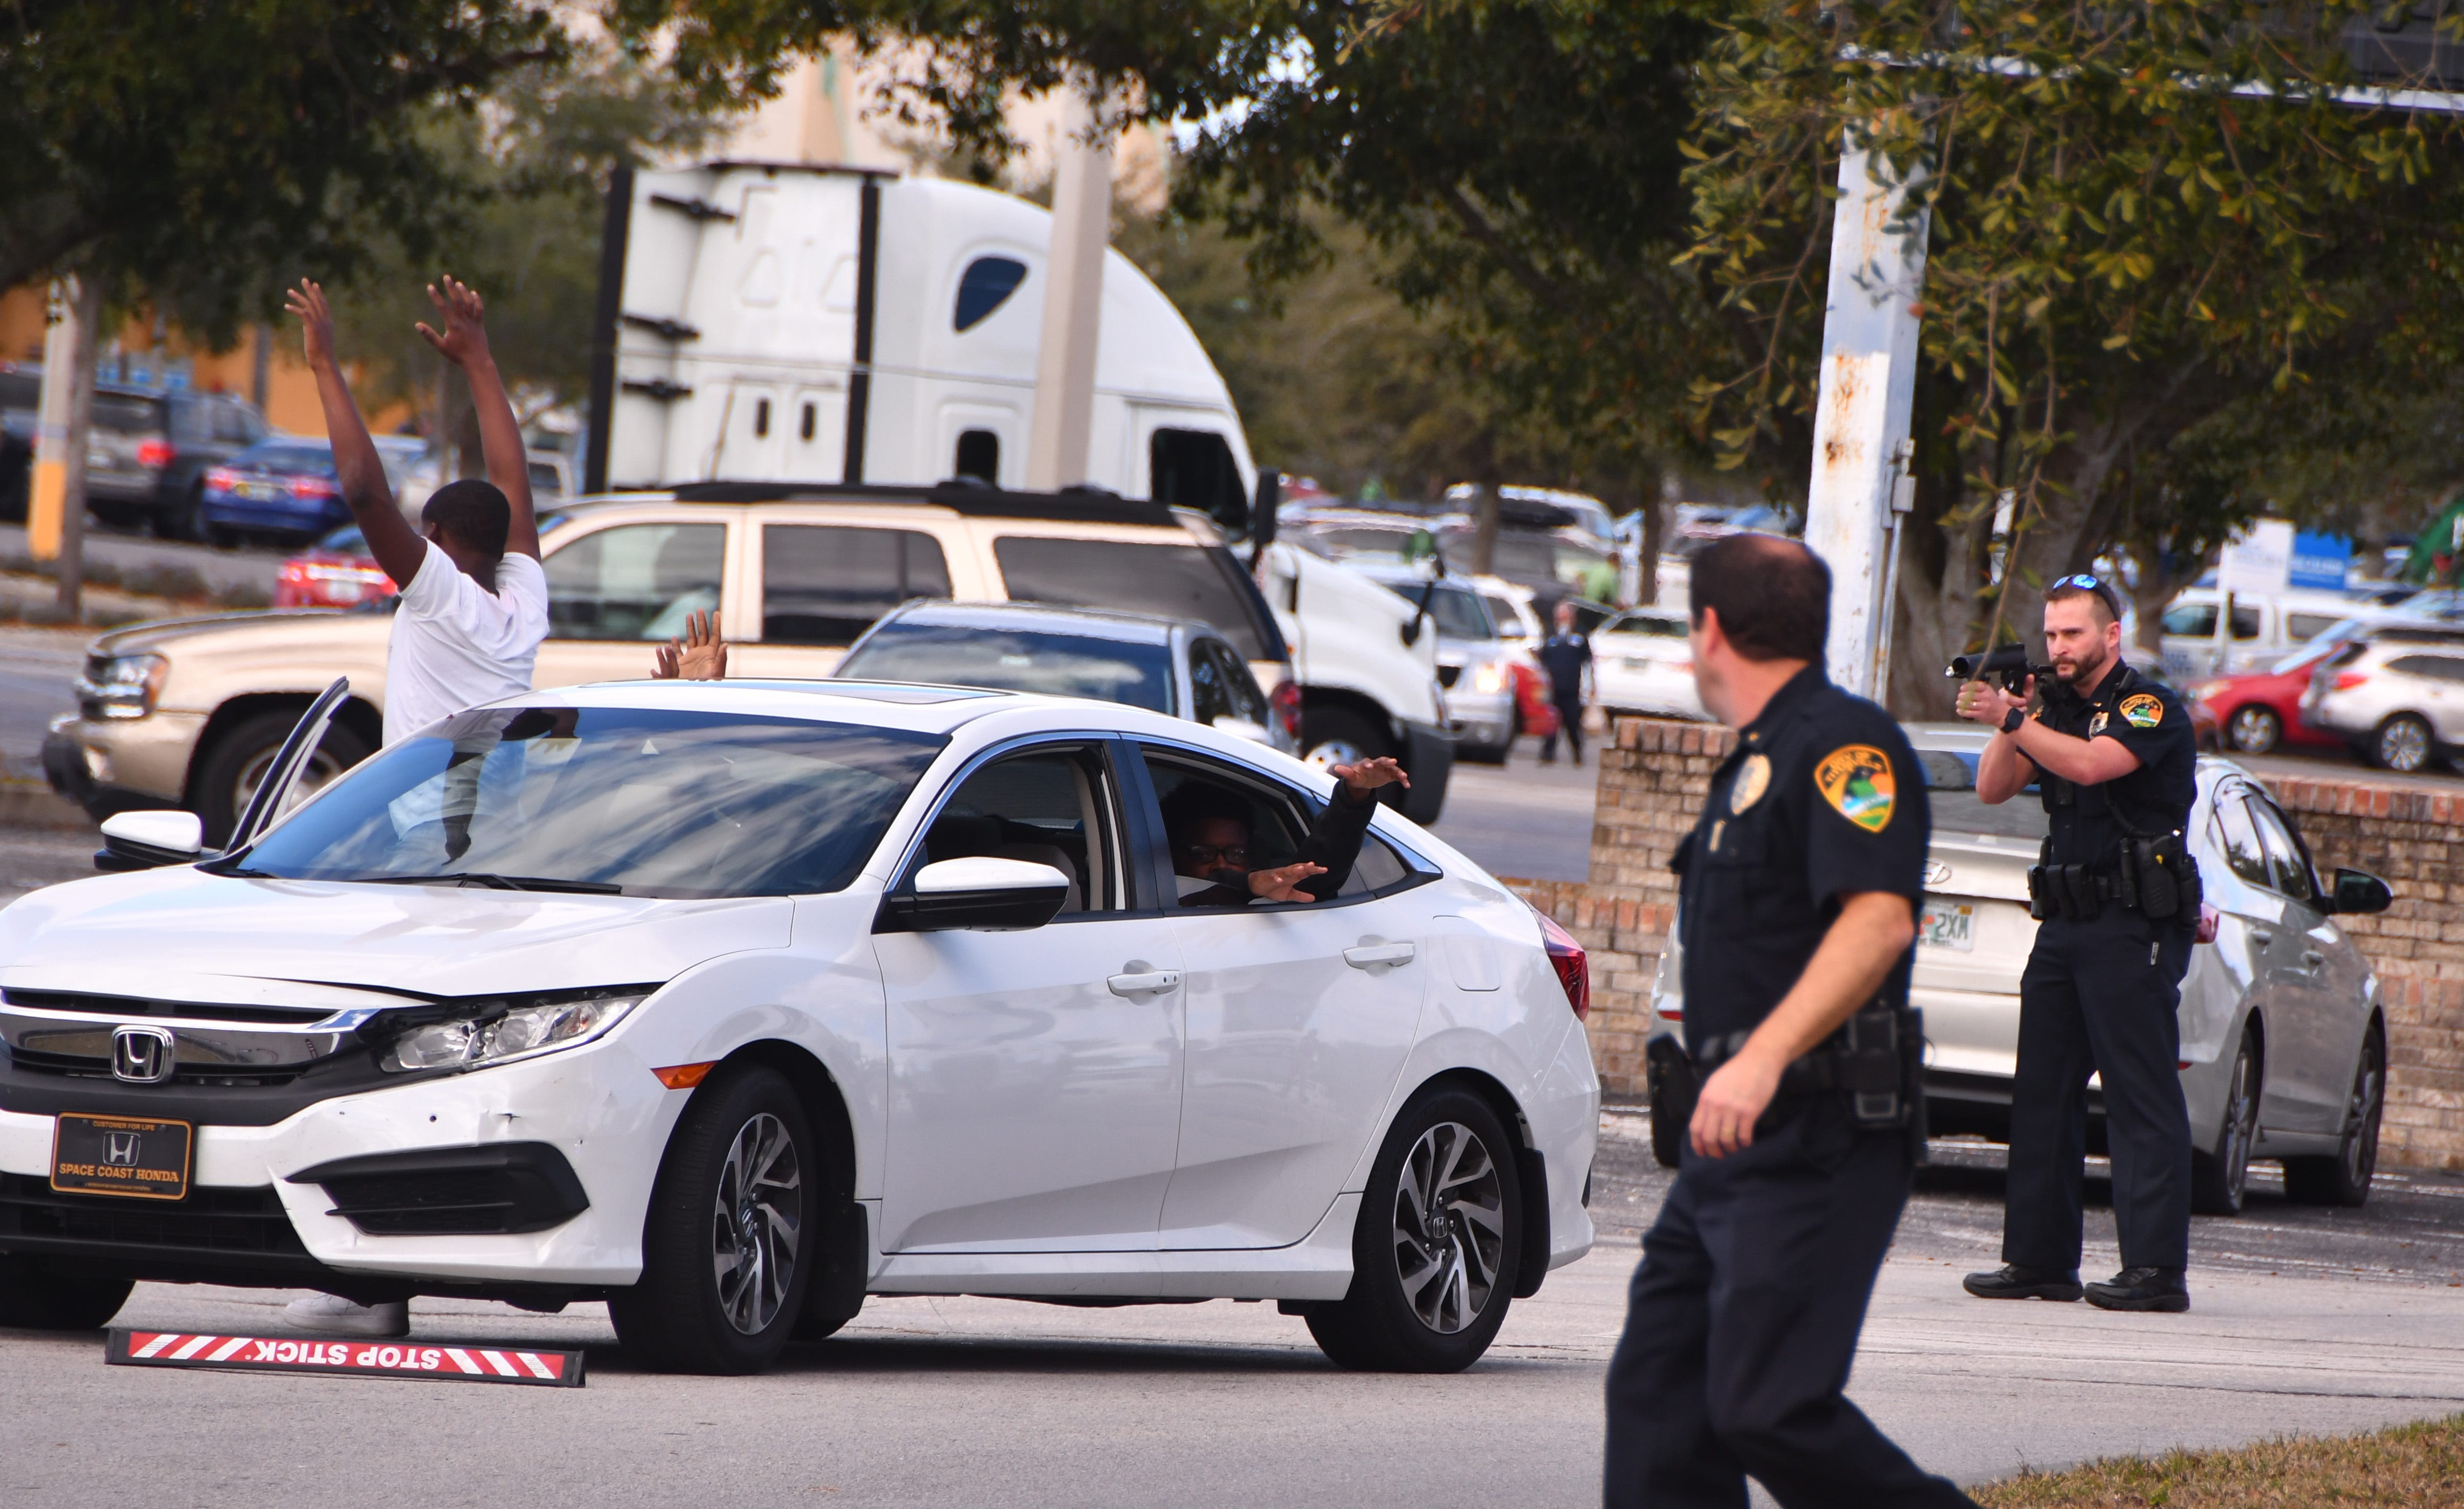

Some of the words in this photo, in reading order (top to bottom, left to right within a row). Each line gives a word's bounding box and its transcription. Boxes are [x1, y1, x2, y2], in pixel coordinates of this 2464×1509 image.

[94, 1120, 126, 1129] CUSTOMER
[59, 1164, 94, 1176] SPACE
[98, 1166, 134, 1179] COAST
[136, 1170, 179, 1182] HONDA
[253, 1340, 348, 1365] STICK
[356, 1346, 441, 1370] STOP
